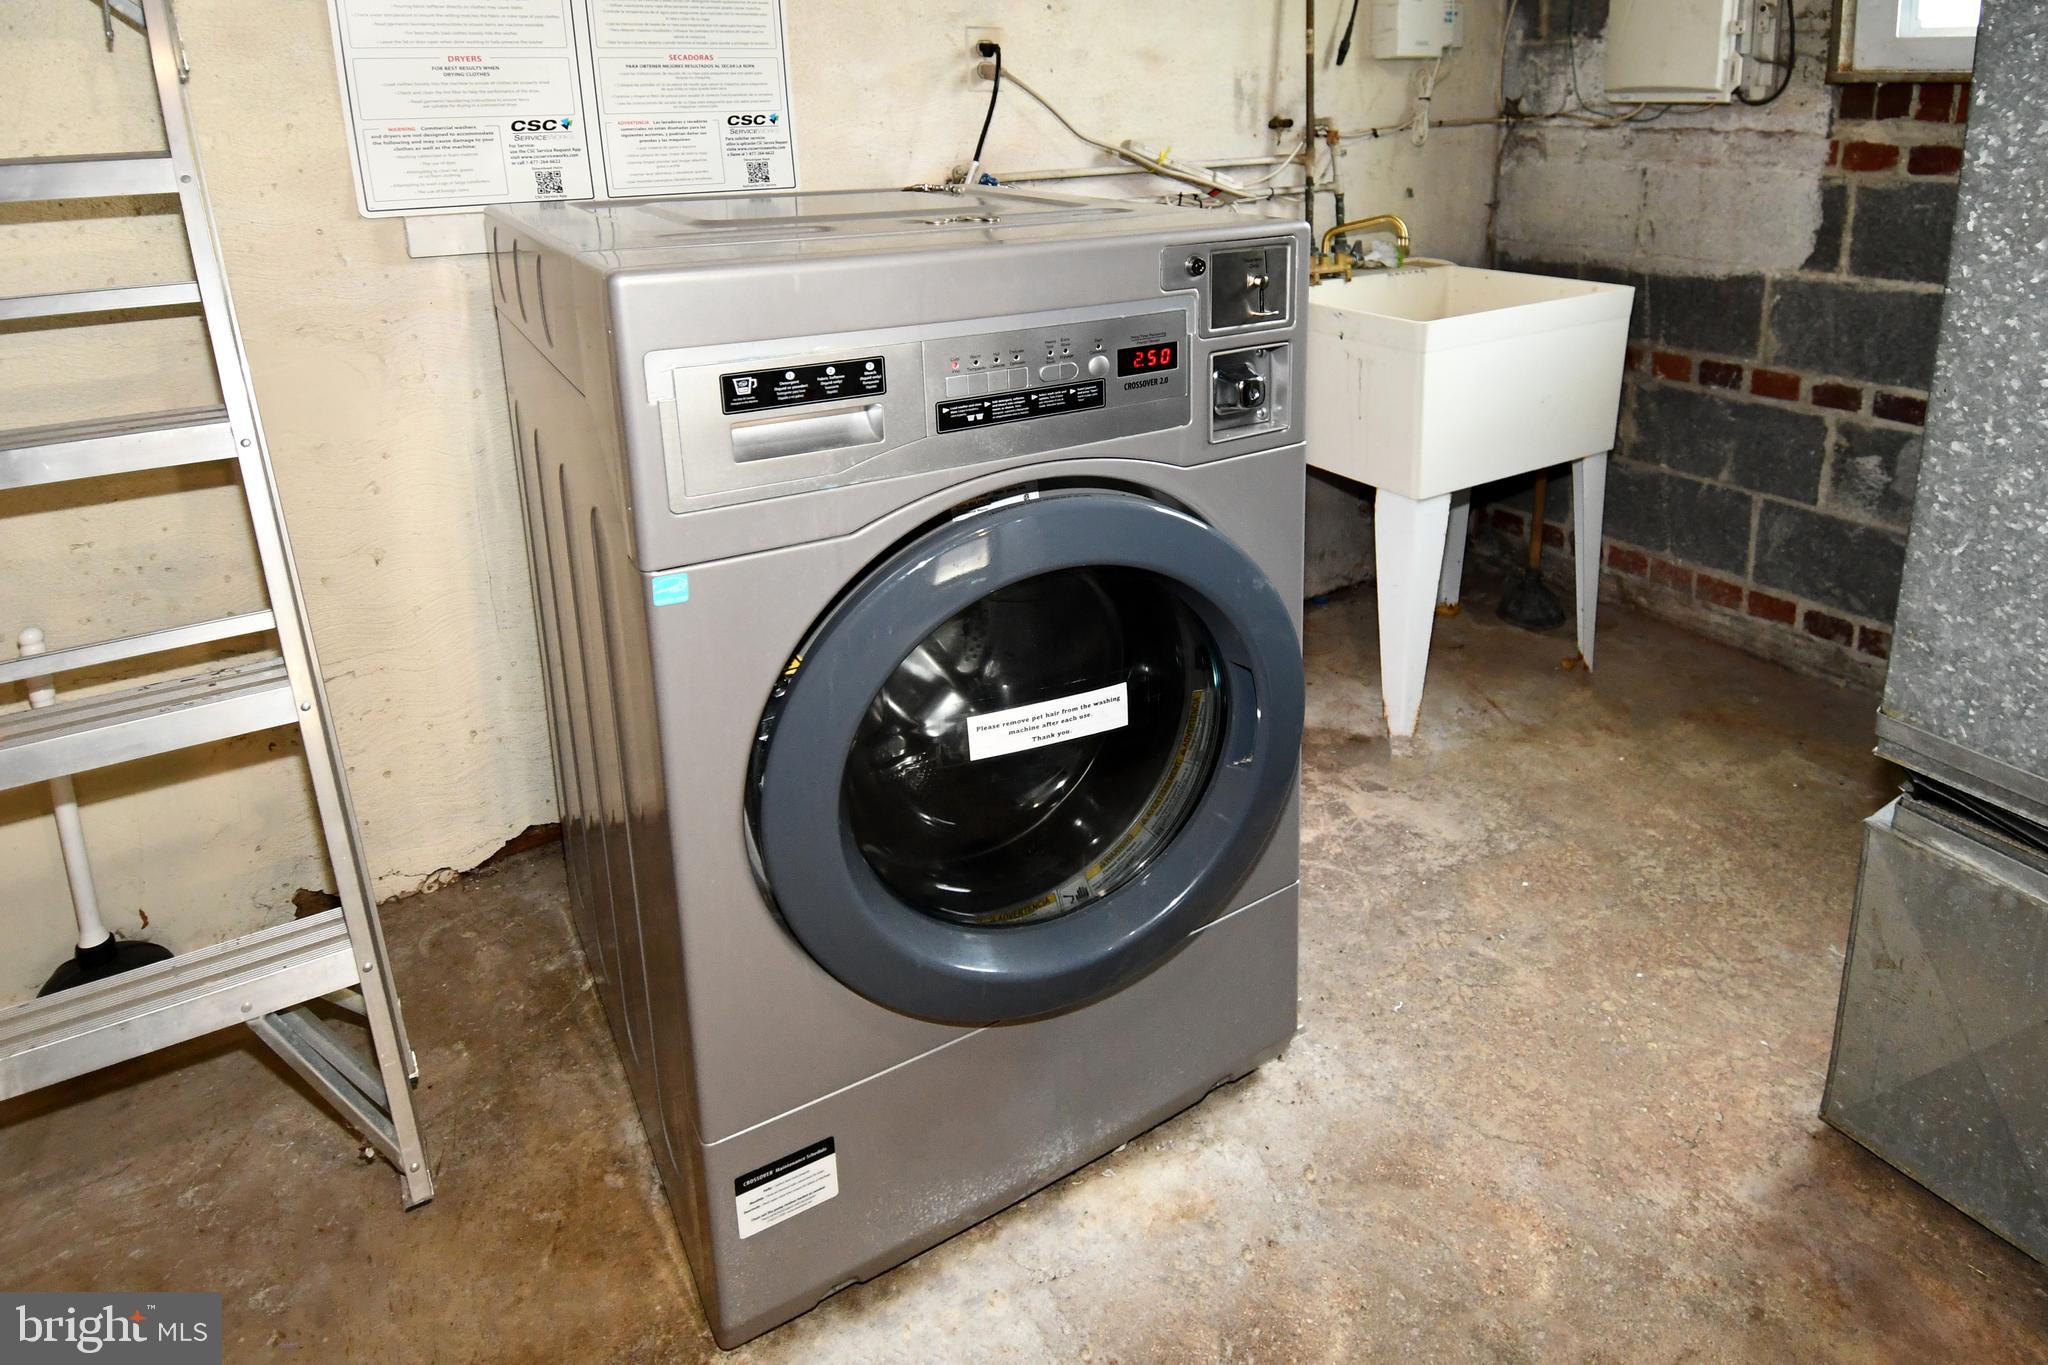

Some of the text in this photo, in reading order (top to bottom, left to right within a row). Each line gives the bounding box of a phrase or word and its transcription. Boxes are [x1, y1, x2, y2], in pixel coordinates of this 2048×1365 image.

[510, 120, 558, 132] CSC
[728, 114, 766, 126] CSC
[1124, 376, 1168, 390] CROSSOVER 2.0
[976, 722, 1000, 732] Please
[1002, 718, 1030, 727] remove
[1032, 714, 1044, 723] pet
[1046, 710, 1060, 718] hair
[1062, 707, 1078, 715] from
[1092, 696, 1121, 706] washing
[1008, 724, 1040, 736] machine
[1042, 720, 1059, 728] after
[1060, 716, 1078, 724] each
[1032, 728, 1072, 742] Thank you.
[742, 1147, 828, 1187] CROSSOVER Maintenance Schedule
